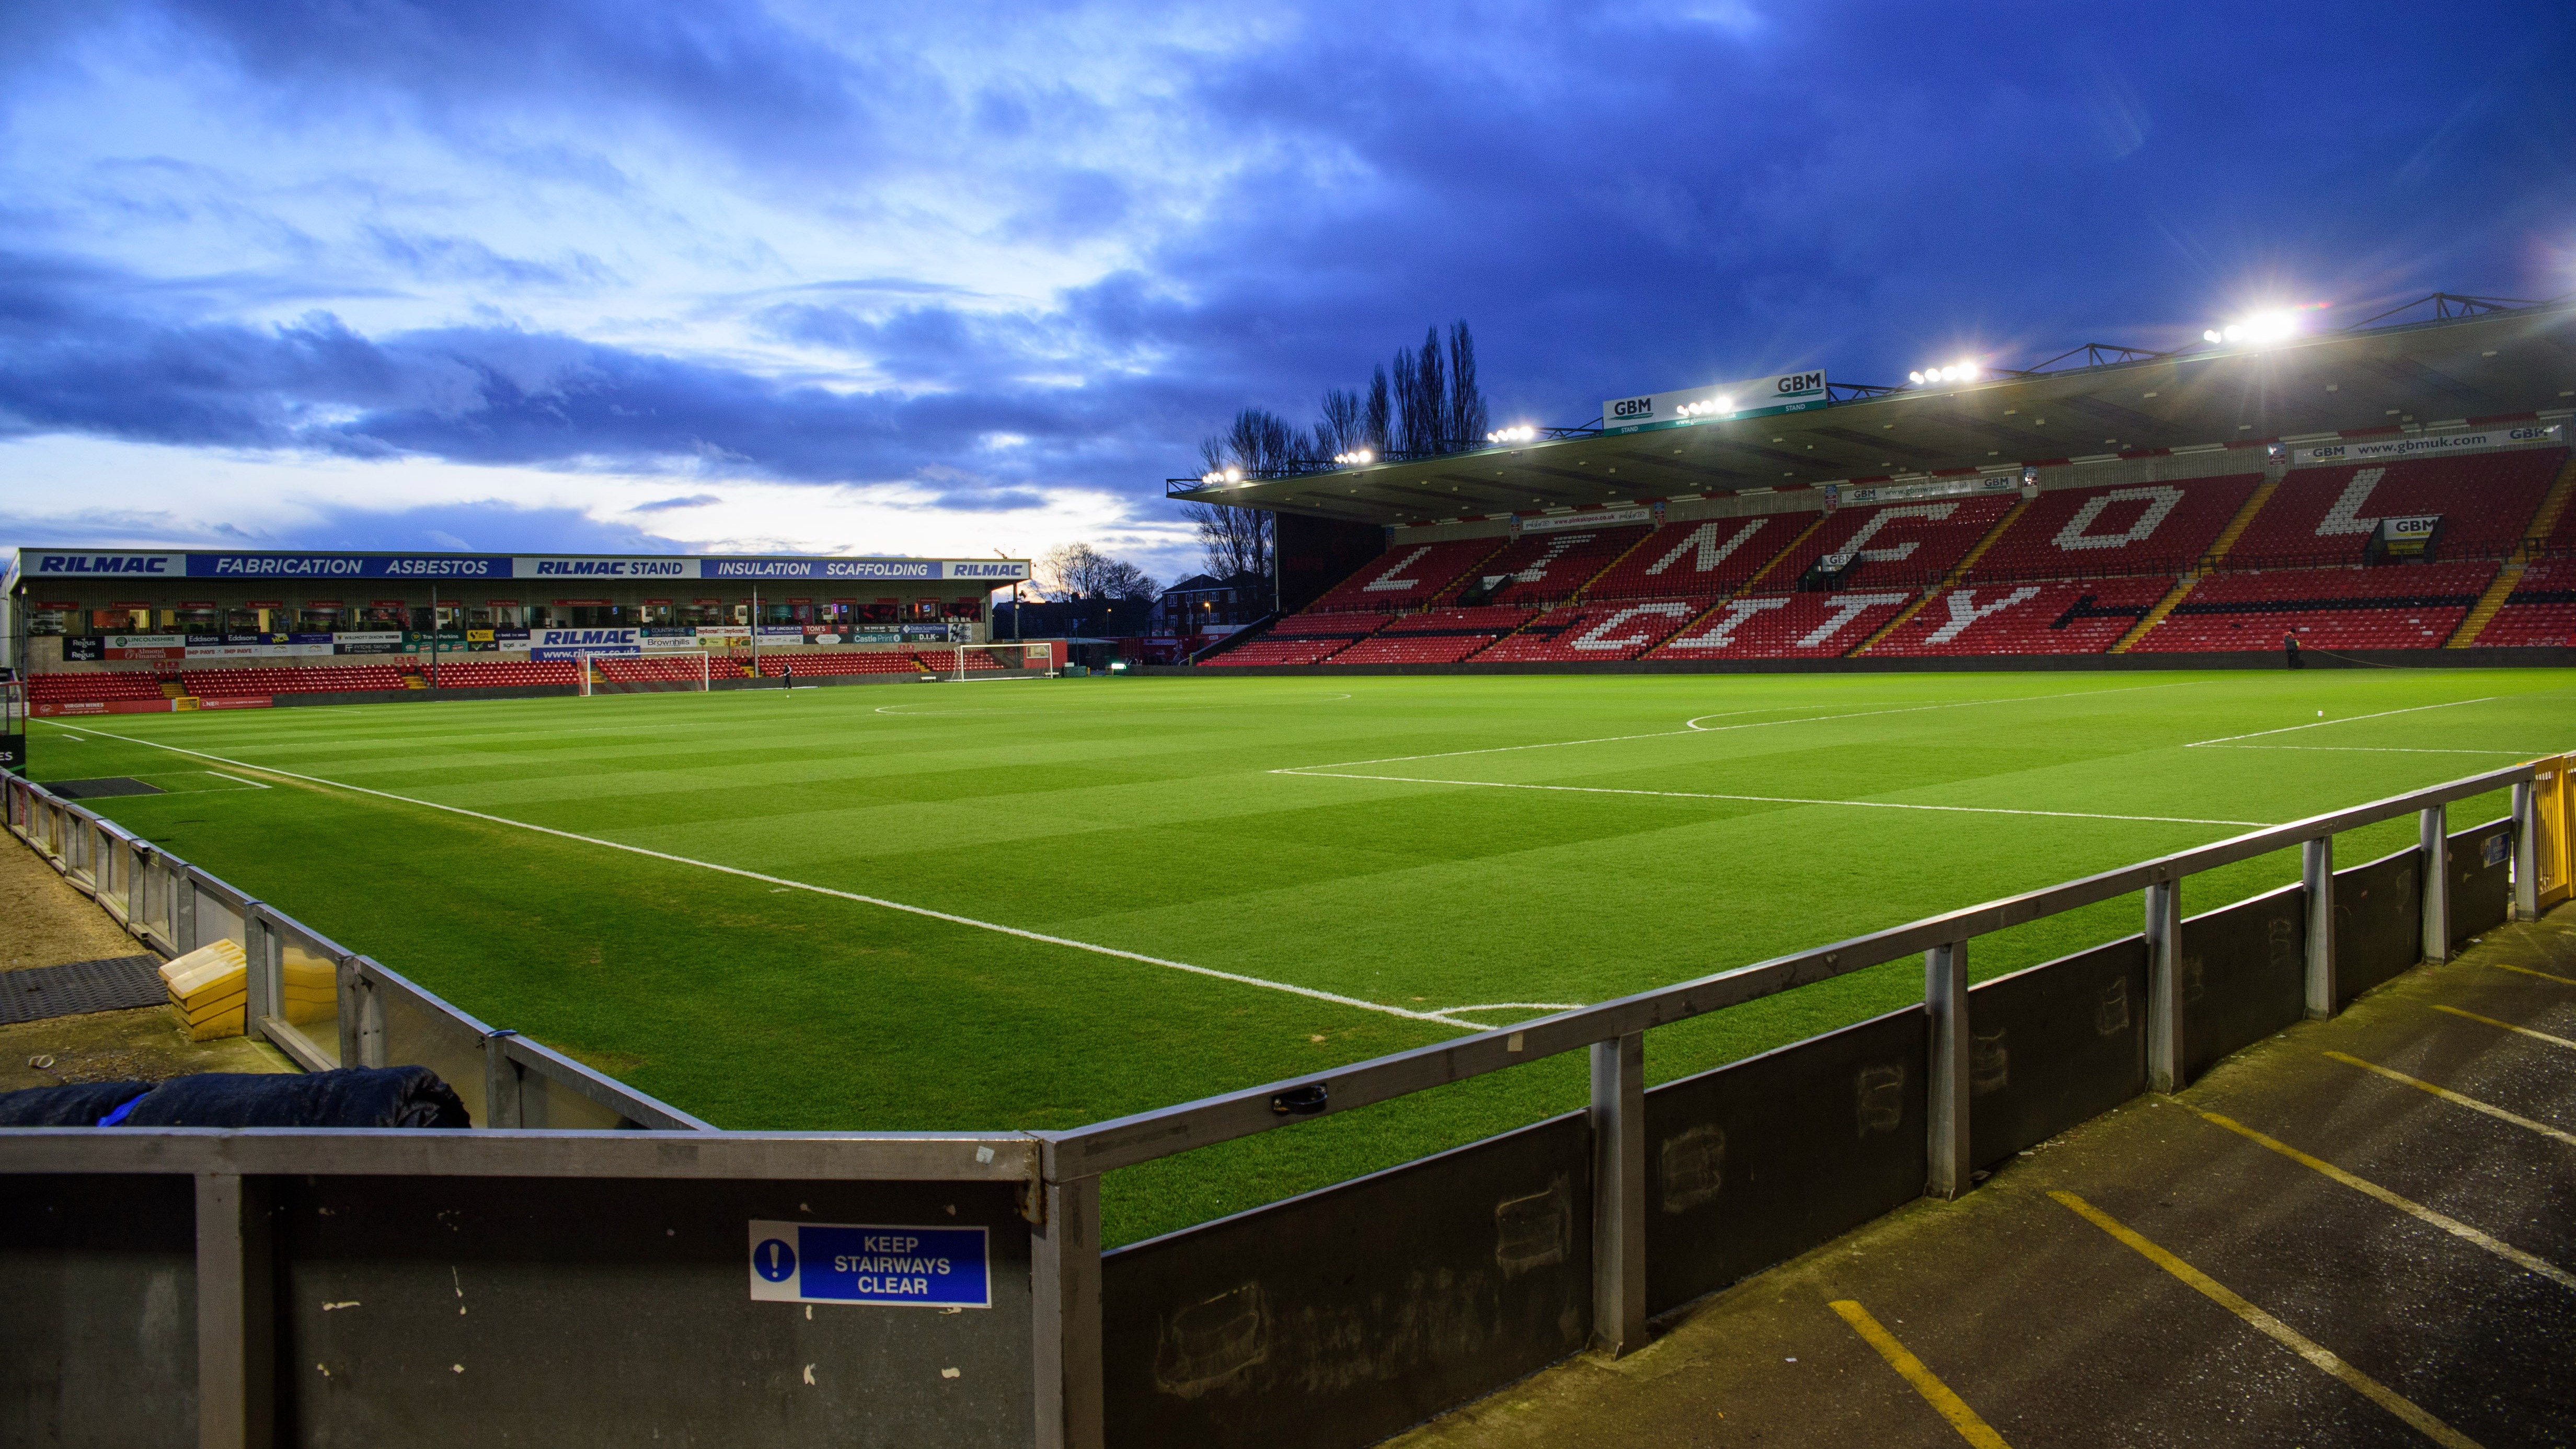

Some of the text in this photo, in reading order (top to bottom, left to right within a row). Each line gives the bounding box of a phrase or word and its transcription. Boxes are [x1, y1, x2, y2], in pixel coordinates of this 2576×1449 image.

[1778, 373, 1821, 393] GBM
[1614, 398, 1651, 416] GBM
[2358, 434, 2487, 453] www.gbmuk.com
[2313, 446, 2345, 457] GBM
[1884, 482, 1969, 496] www.gbmwaste.co.uk
[1984, 477, 2009, 487] GBM
[1854, 490, 1876, 498] GBM
[2396, 519, 2436, 532] GBM
[39, 556, 168, 573] RILMAC
[216, 558, 489, 574] FABRICATION ASBESTOS
[537, 561, 683, 575] RILMAC STAND
[718, 562, 928, 576] INSULATION SCAFFOLDING
[954, 565, 1023, 576] RILMAC
[73, 638, 96, 648] Regus
[543, 630, 637, 645] RILMAC
[72, 649, 95, 661] Regus
[864, 1236, 918, 1253] KEEP
[834, 1256, 951, 1275] STAIRWAYS
[858, 1276, 928, 1294] CLEAR
